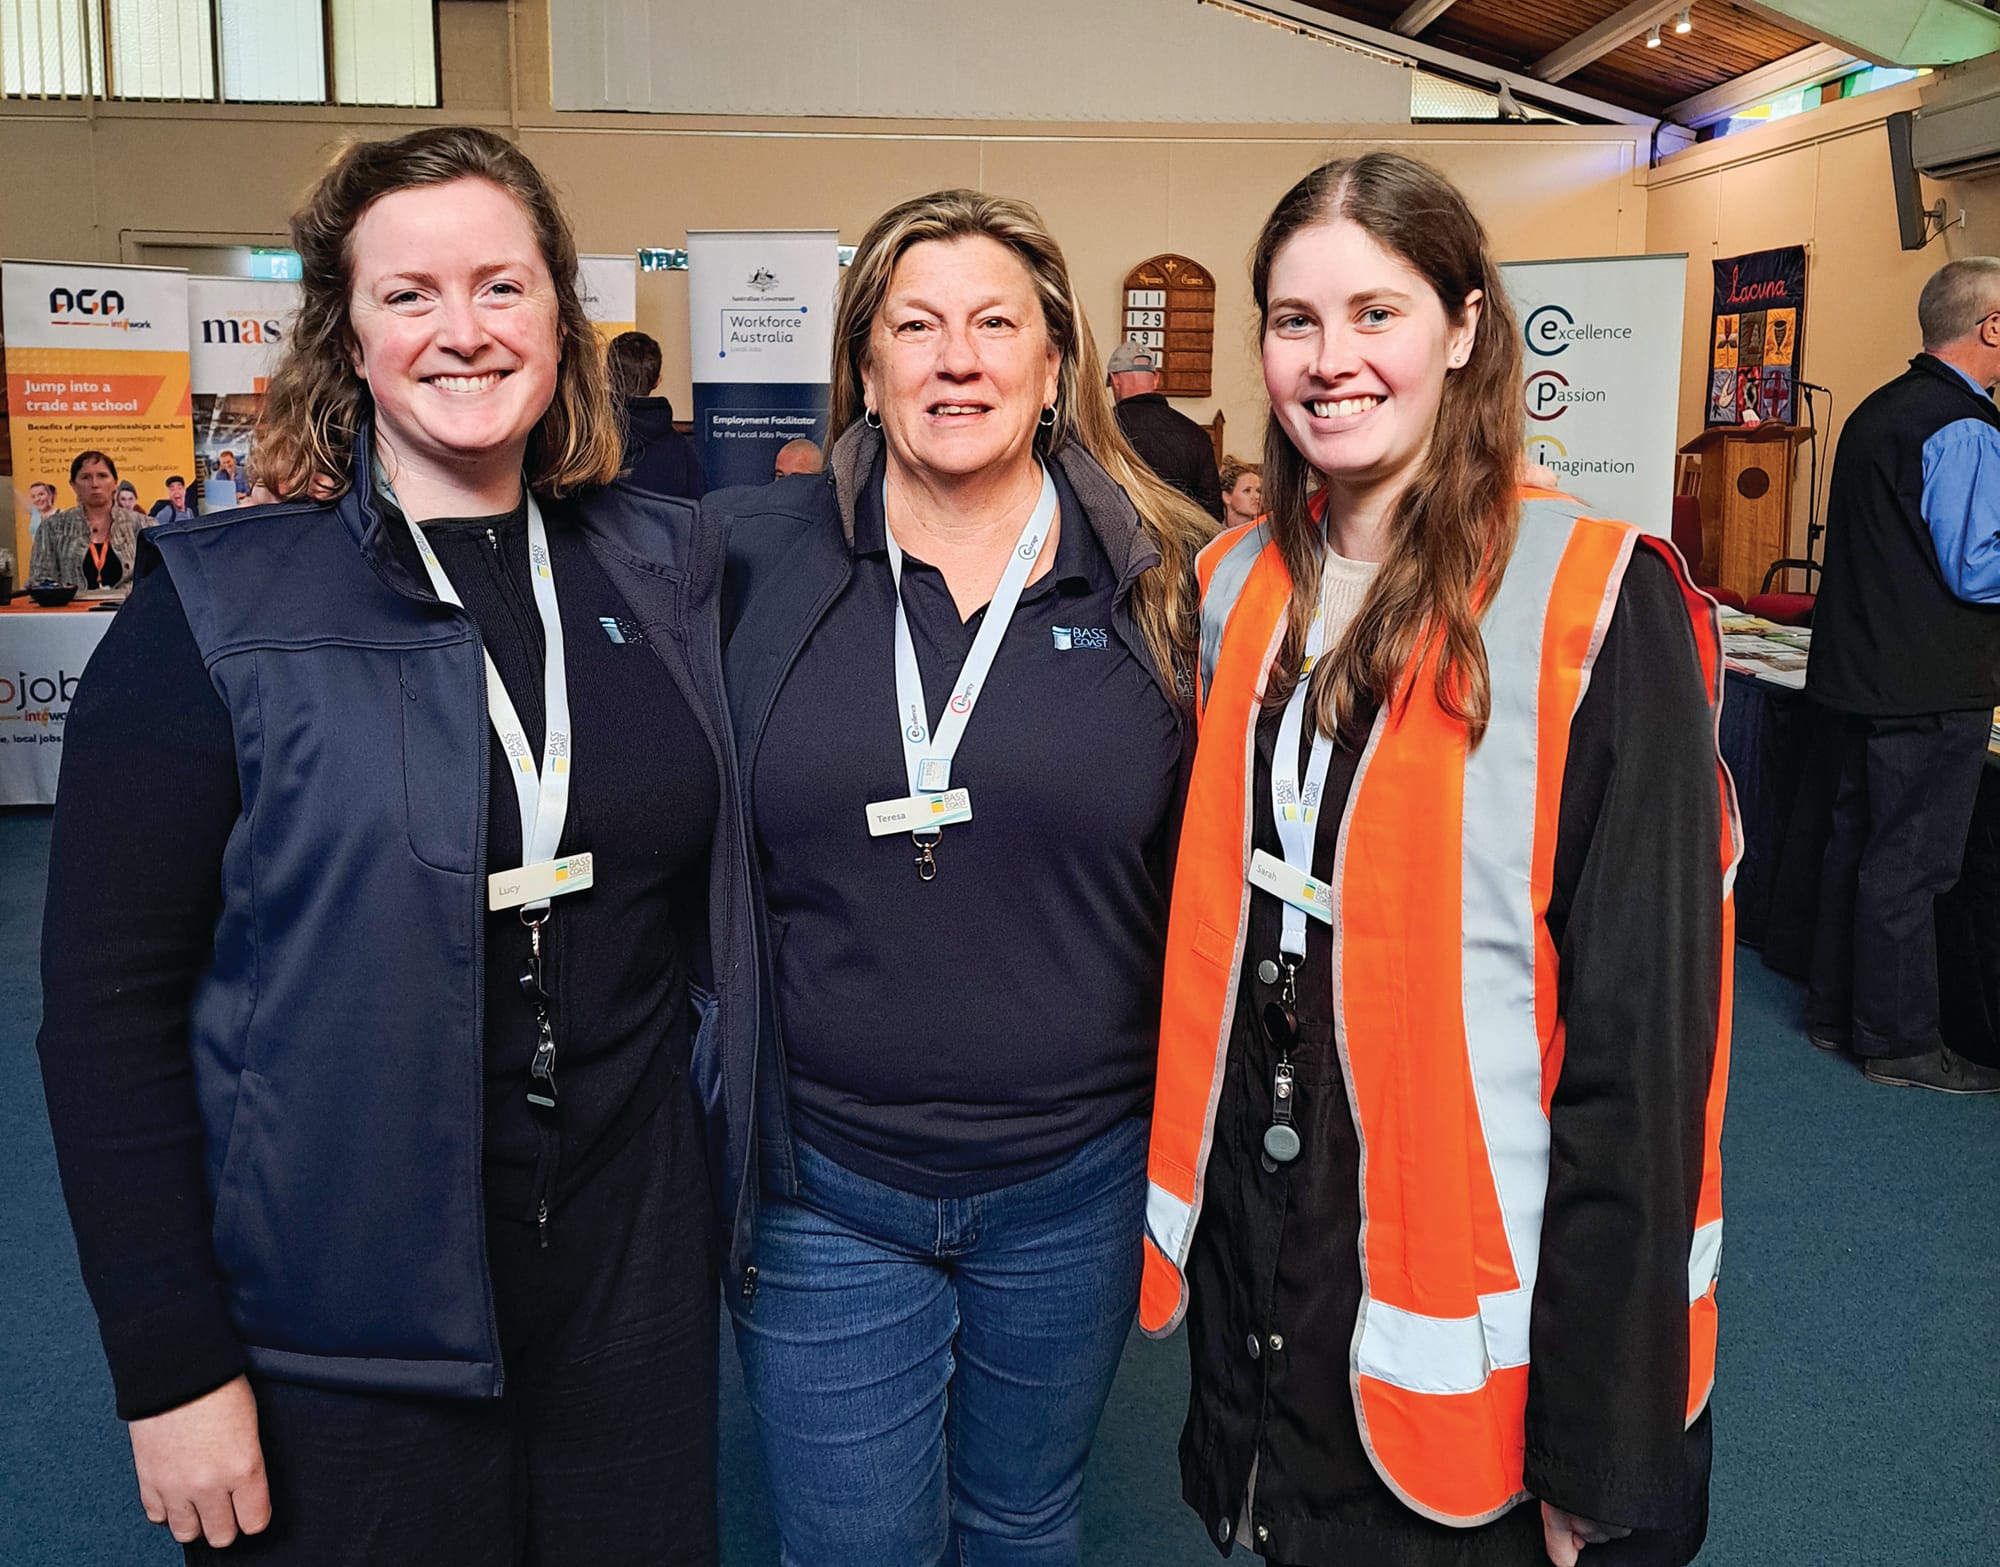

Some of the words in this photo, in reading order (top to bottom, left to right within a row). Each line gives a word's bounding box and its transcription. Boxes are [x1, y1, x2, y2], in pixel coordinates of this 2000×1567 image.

[1726, 264, 1788, 304] Lacuna
[49, 288, 125, 315] AGA
[1132, 292, 1161, 305] 111
[729, 315, 802, 328] Workforce
[1131, 312, 1161, 326] 129
[202, 318, 282, 345] mas
[730, 330, 794, 343] Australia
[1541, 320, 1632, 340] excellence
[1130, 332, 1159, 345] 691
[24, 380, 66, 395] Jump
[70, 379, 99, 392] into
[102, 383, 112, 392] a
[1537, 382, 1606, 411] passion
[26, 399, 69, 411] trade
[72, 401, 88, 411] at
[91, 399, 138, 411] school
[713, 415, 770, 426] Employment
[771, 415, 817, 425] Facilitator
[713, 430, 723, 438] for
[737, 431, 757, 439] Local
[759, 431, 774, 439] Jobs
[776, 431, 805, 440] Program
[1073, 627, 1107, 639] BASS
[1073, 637, 1109, 648] COAST
[13, 734, 36, 742] local
[502, 732, 519, 757] BASS
[511, 733, 526, 756] COAST
[549, 731, 559, 756] BASS
[559, 733, 567, 757] COAST
[944, 791, 966, 803] BASS
[1276, 779, 1287, 805] BASS
[1286, 779, 1296, 804] COAST
[1303, 781, 1314, 806] BASS
[1309, 783, 1320, 807] COAST
[945, 800, 967, 810] COAST
[877, 813, 907, 824] Teresa
[569, 855, 591, 869] BASS
[569, 865, 590, 876] COAST
[1256, 864, 1278, 882] Sarah
[498, 885, 521, 896] Lucy
